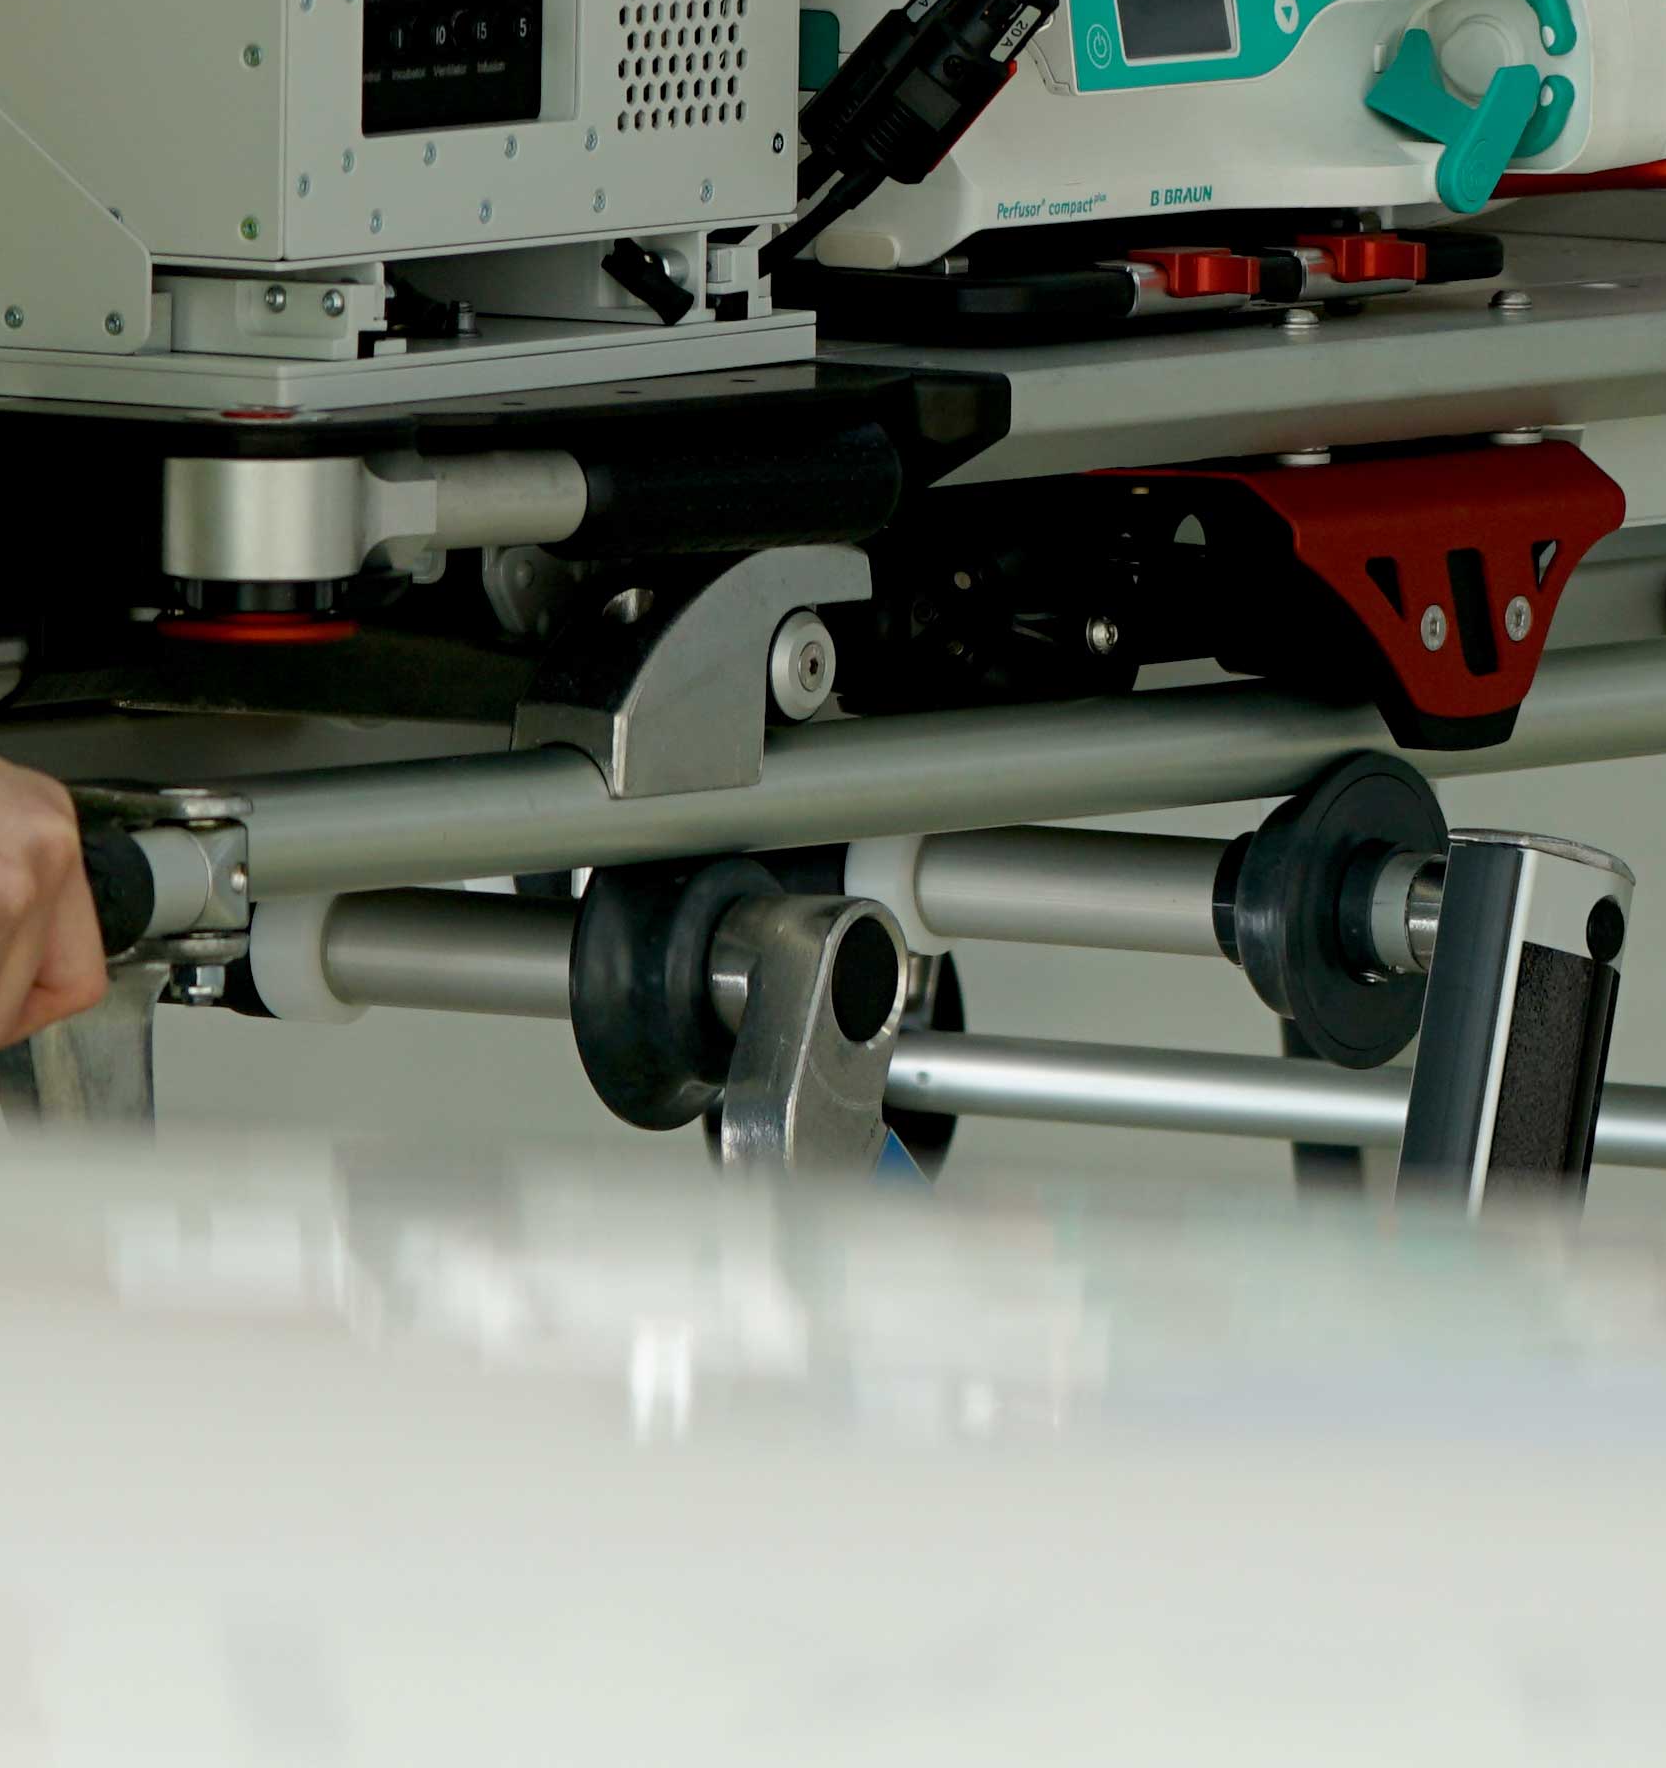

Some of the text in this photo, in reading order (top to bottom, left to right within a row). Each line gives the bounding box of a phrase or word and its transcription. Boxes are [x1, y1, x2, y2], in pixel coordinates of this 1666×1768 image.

[435, 24, 447, 45] 10
[476, 21, 488, 40] 15
[519, 17, 528, 38] 5
[1000, 19, 1029, 49] 20 A
[1164, 186, 1213, 205] BRAUN
